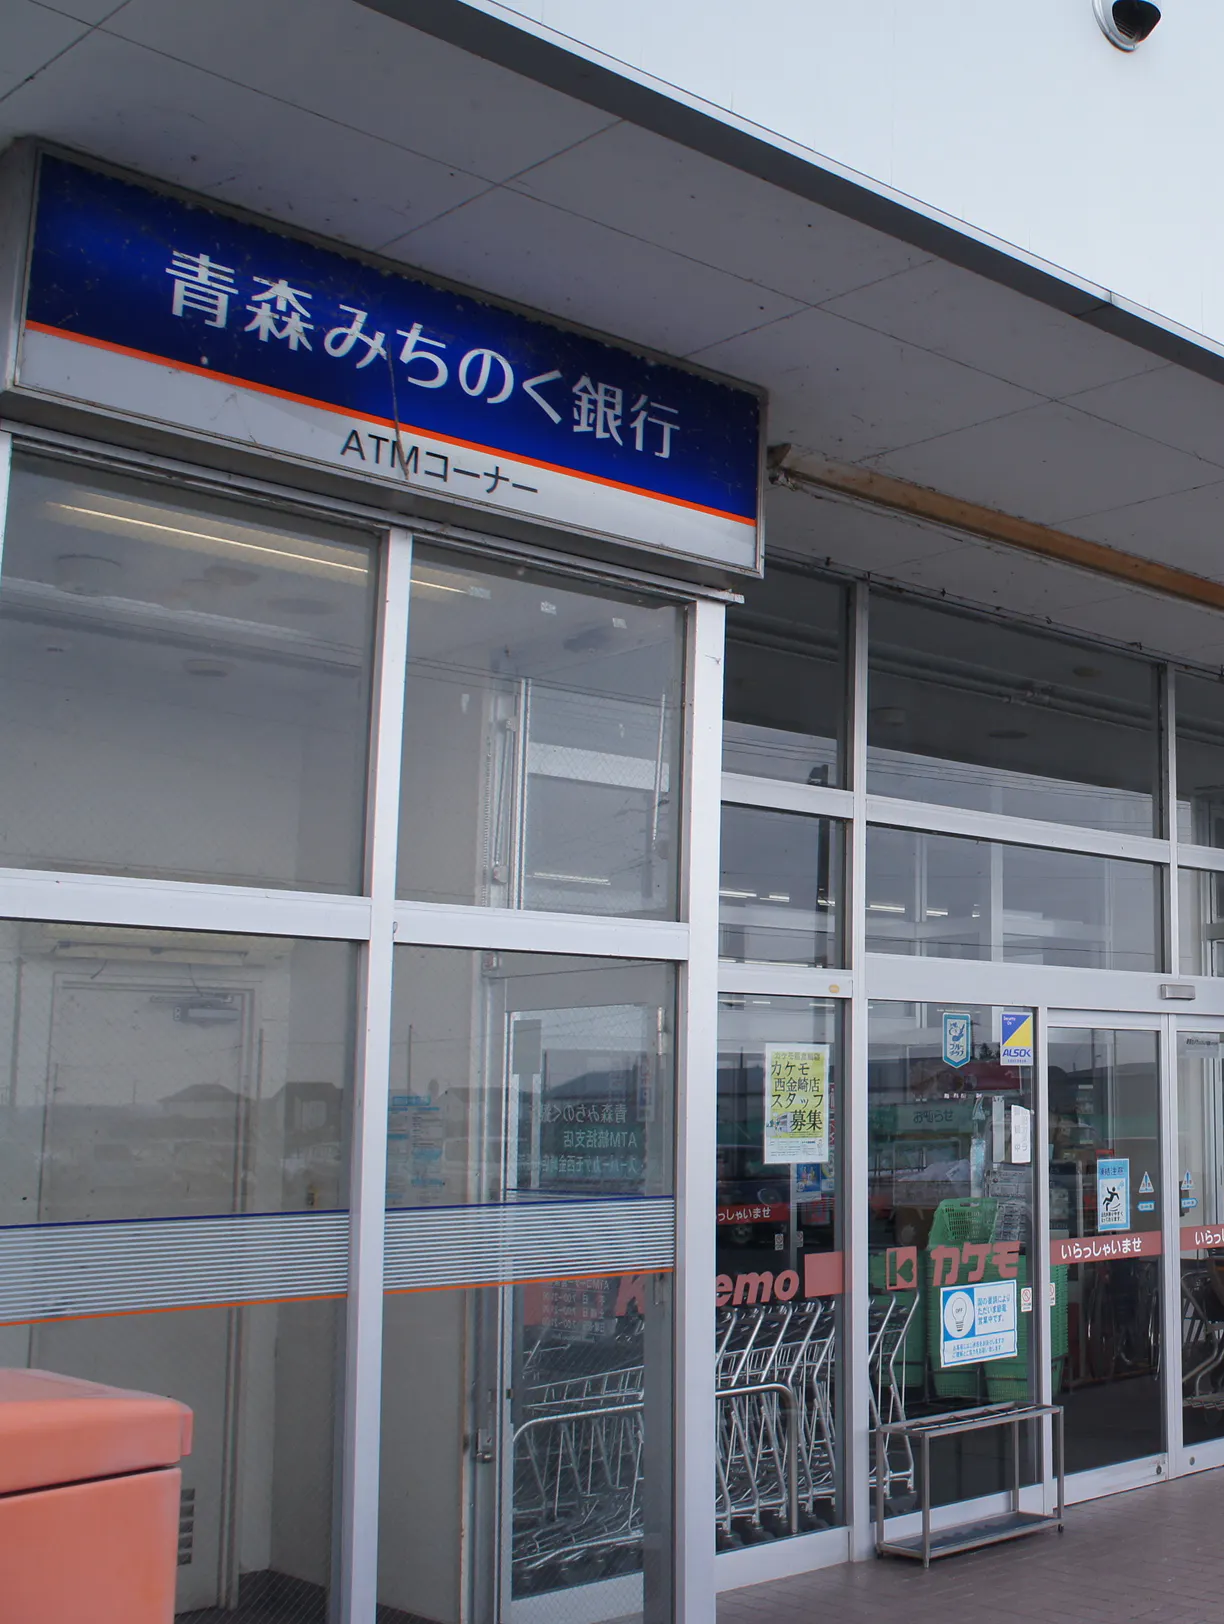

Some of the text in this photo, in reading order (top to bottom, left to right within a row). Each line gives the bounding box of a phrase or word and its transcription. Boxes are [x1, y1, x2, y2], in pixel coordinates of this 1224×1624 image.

[165, 250, 681, 460] 青森みちのく銀行
[340, 429, 538, 494] ATMコーナー
[1002, 1048, 1031, 1058] ALSOK
[770, 1061, 810, 1076] カケモ
[774, 1077, 820, 1092] 西金崎店
[771, 1093, 824, 1109] スタッフ
[791, 1109, 823, 1132] 募集
[913, 1109, 954, 1123] お知らせ
[1060, 1237, 1142, 1260] いらっしゃいませ
[930, 1240, 1020, 1287] カケモ
